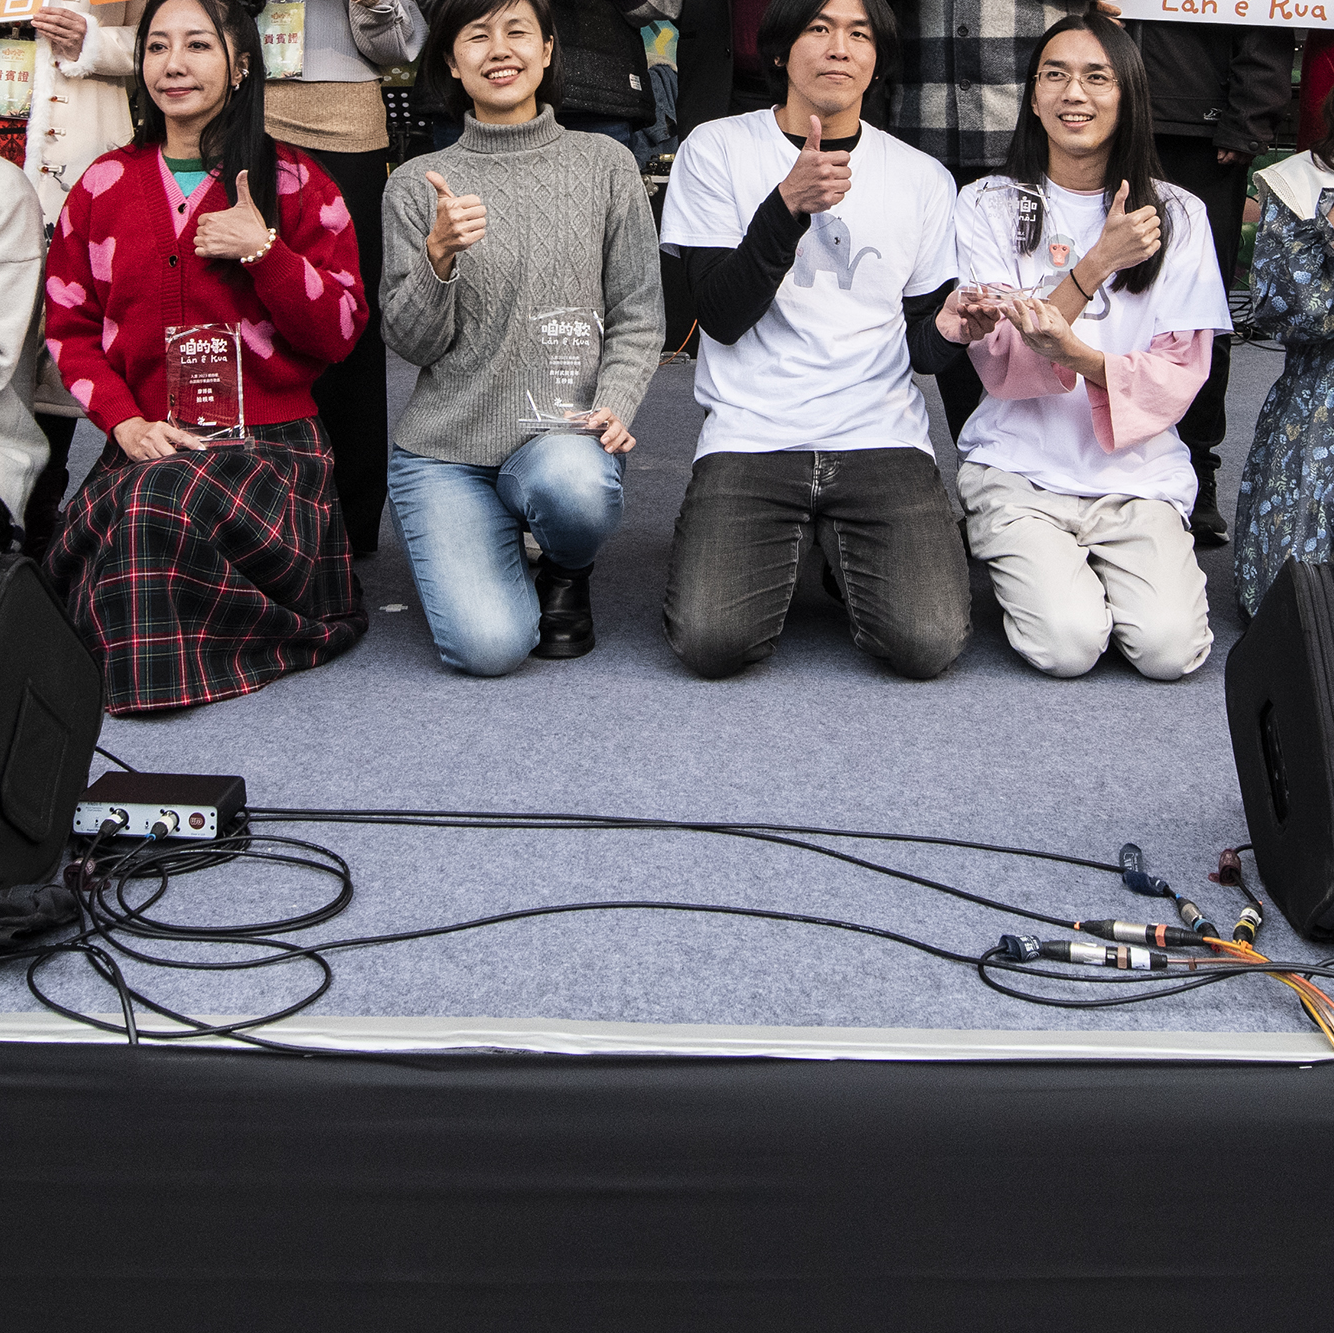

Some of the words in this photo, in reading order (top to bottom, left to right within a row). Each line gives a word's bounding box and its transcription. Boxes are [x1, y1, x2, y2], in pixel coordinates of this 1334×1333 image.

[541, 320, 591, 337] 咱的歌
[179, 337, 228, 355] 咱的歌
